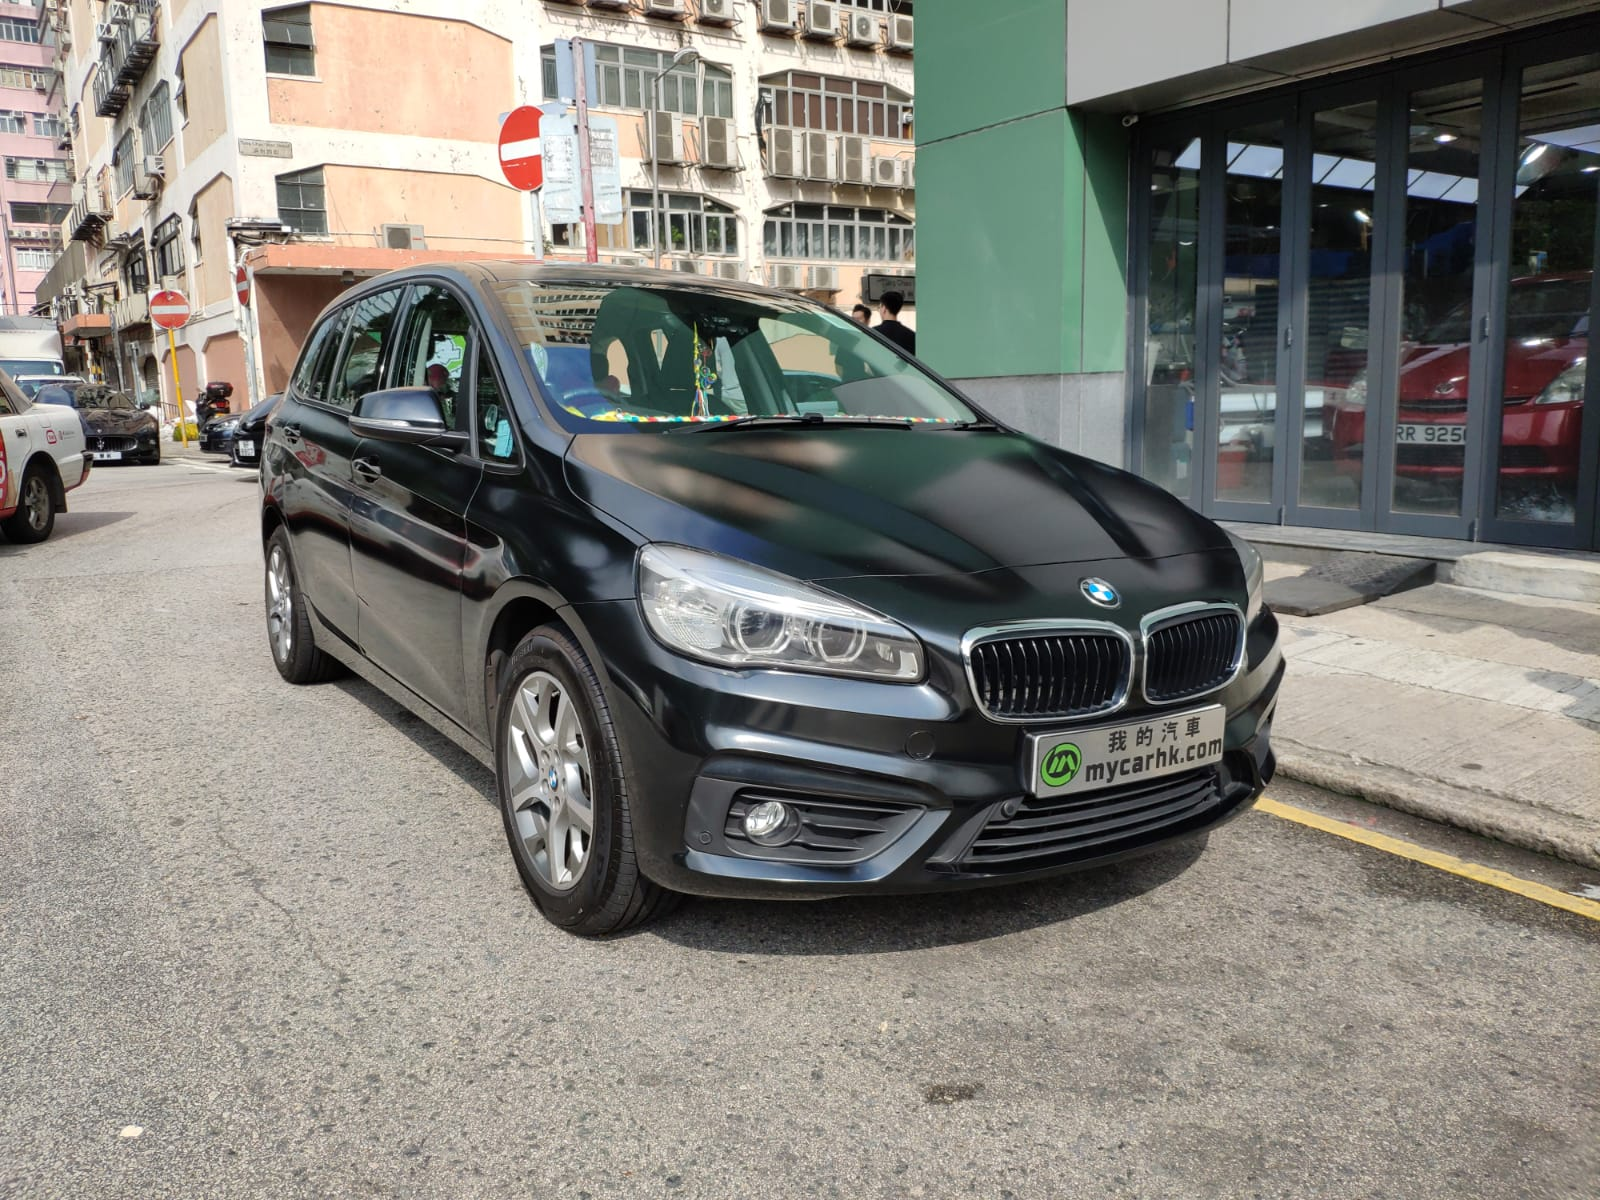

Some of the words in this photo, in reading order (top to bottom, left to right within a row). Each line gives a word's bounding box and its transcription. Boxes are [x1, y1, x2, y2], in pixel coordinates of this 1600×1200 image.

[1108, 716, 1201, 753] 我的汽車
[1085, 737, 1222, 783] mycarhk.com
